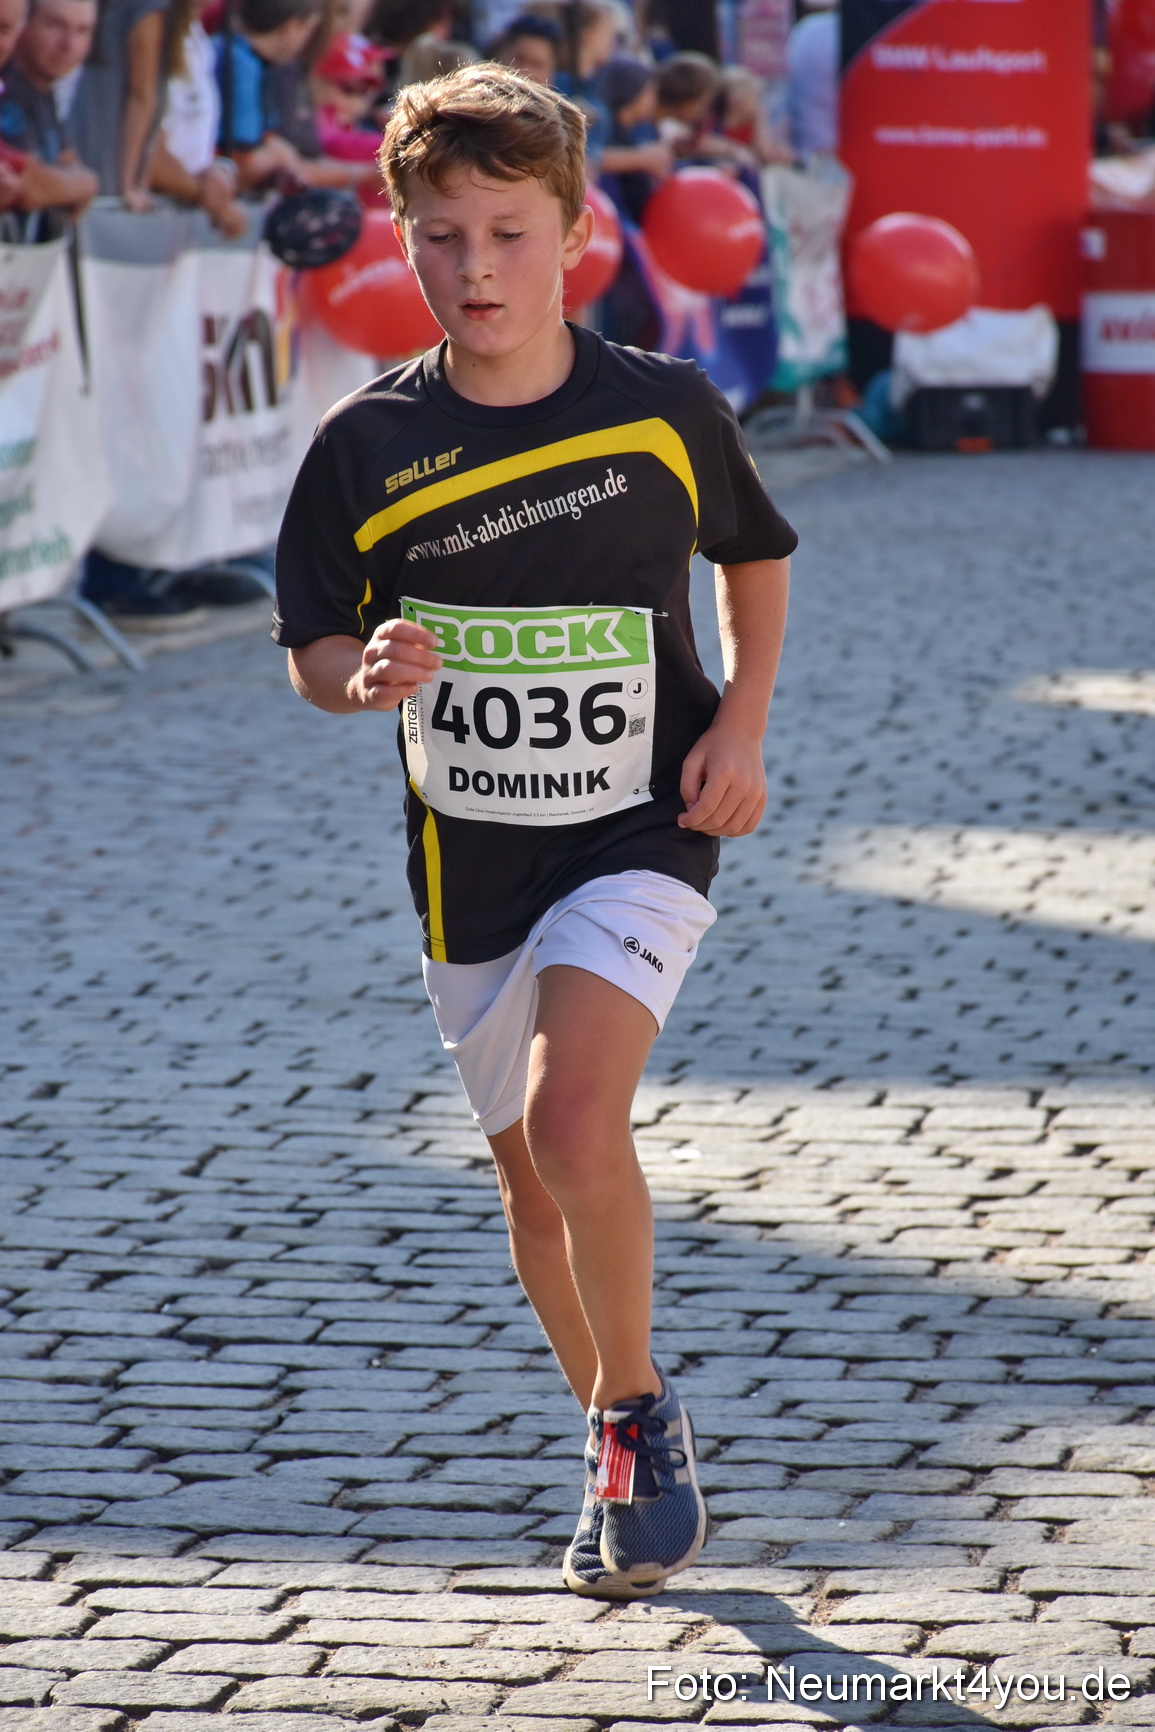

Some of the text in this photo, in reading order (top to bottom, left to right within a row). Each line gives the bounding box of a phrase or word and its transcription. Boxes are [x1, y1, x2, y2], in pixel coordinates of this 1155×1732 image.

[385, 446, 463, 495] saller
[405, 467, 628, 562] www.mk-abdichtungen.de
[416, 611, 632, 666] BOCK
[408, 695, 418, 745] ZEITGEM
[431, 680, 627, 750] 4036
[448, 765, 611, 799] DOMINIK
[639, 948, 663, 974] JAKO
